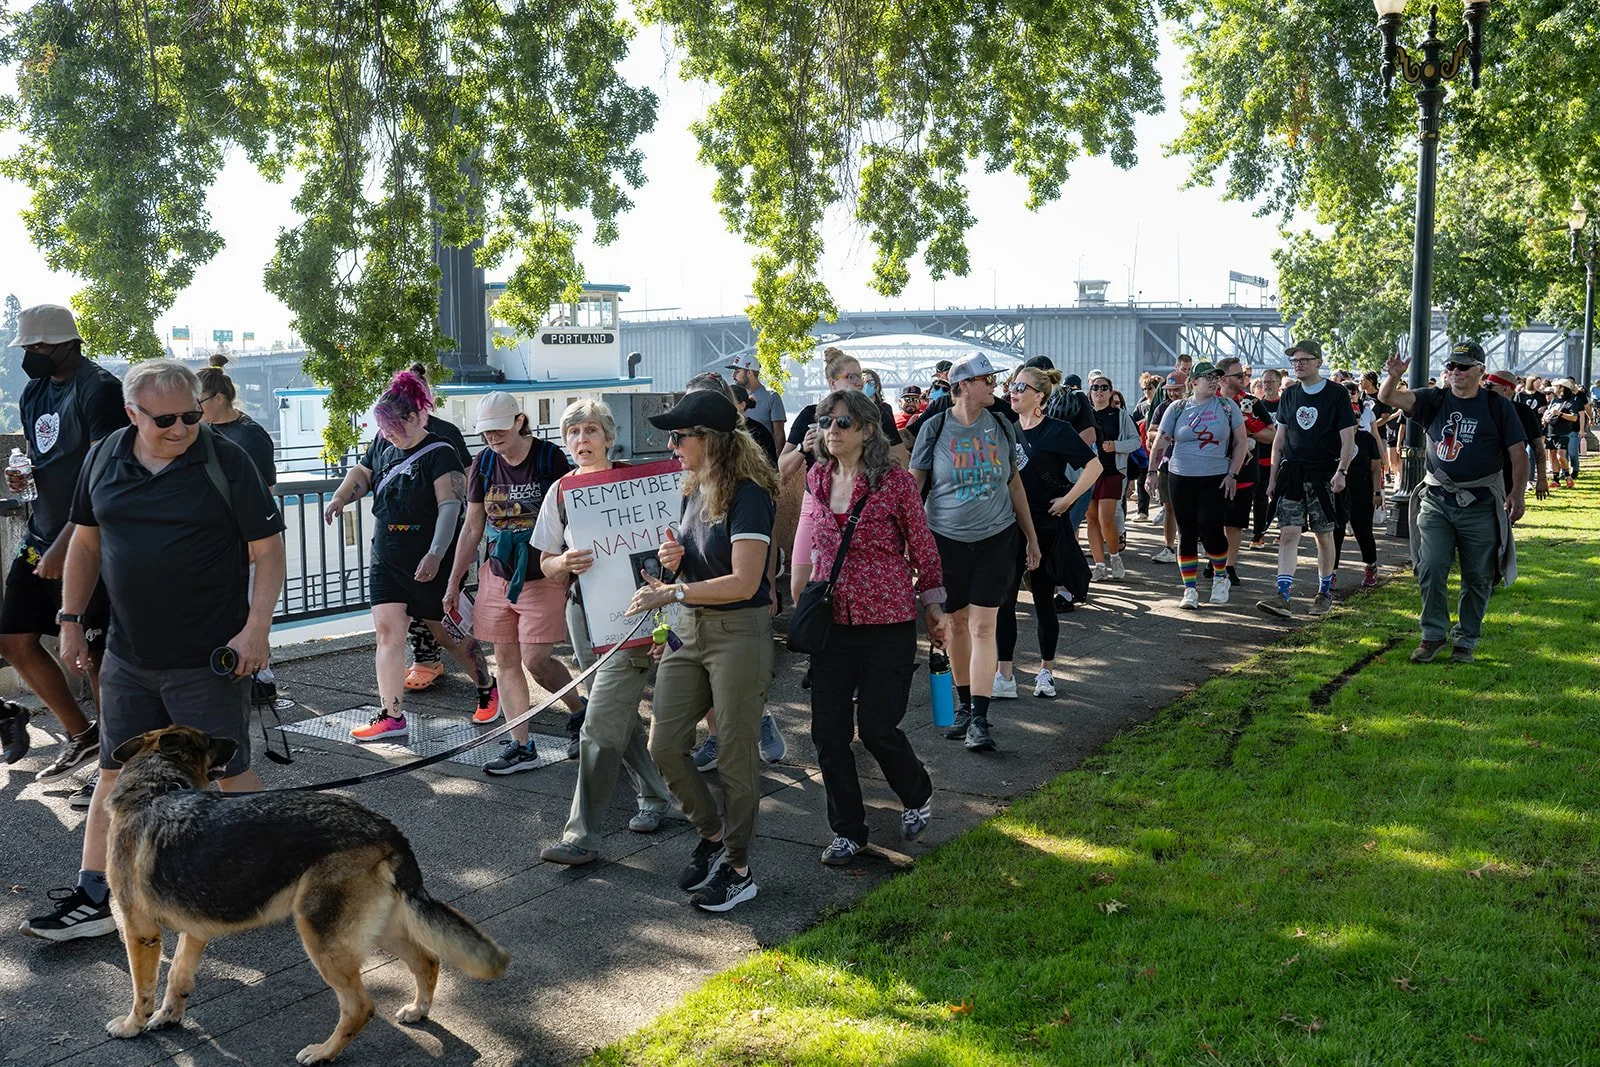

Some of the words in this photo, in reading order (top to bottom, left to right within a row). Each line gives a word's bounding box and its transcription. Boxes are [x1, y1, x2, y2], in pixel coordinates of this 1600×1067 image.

[551, 334, 606, 344] PORTLAND
[1460, 424, 1477, 435] JAZZ
[510, 482, 541, 493] UTAH
[510, 490, 542, 500] ROCKS
[600, 500, 672, 528] THEIR
